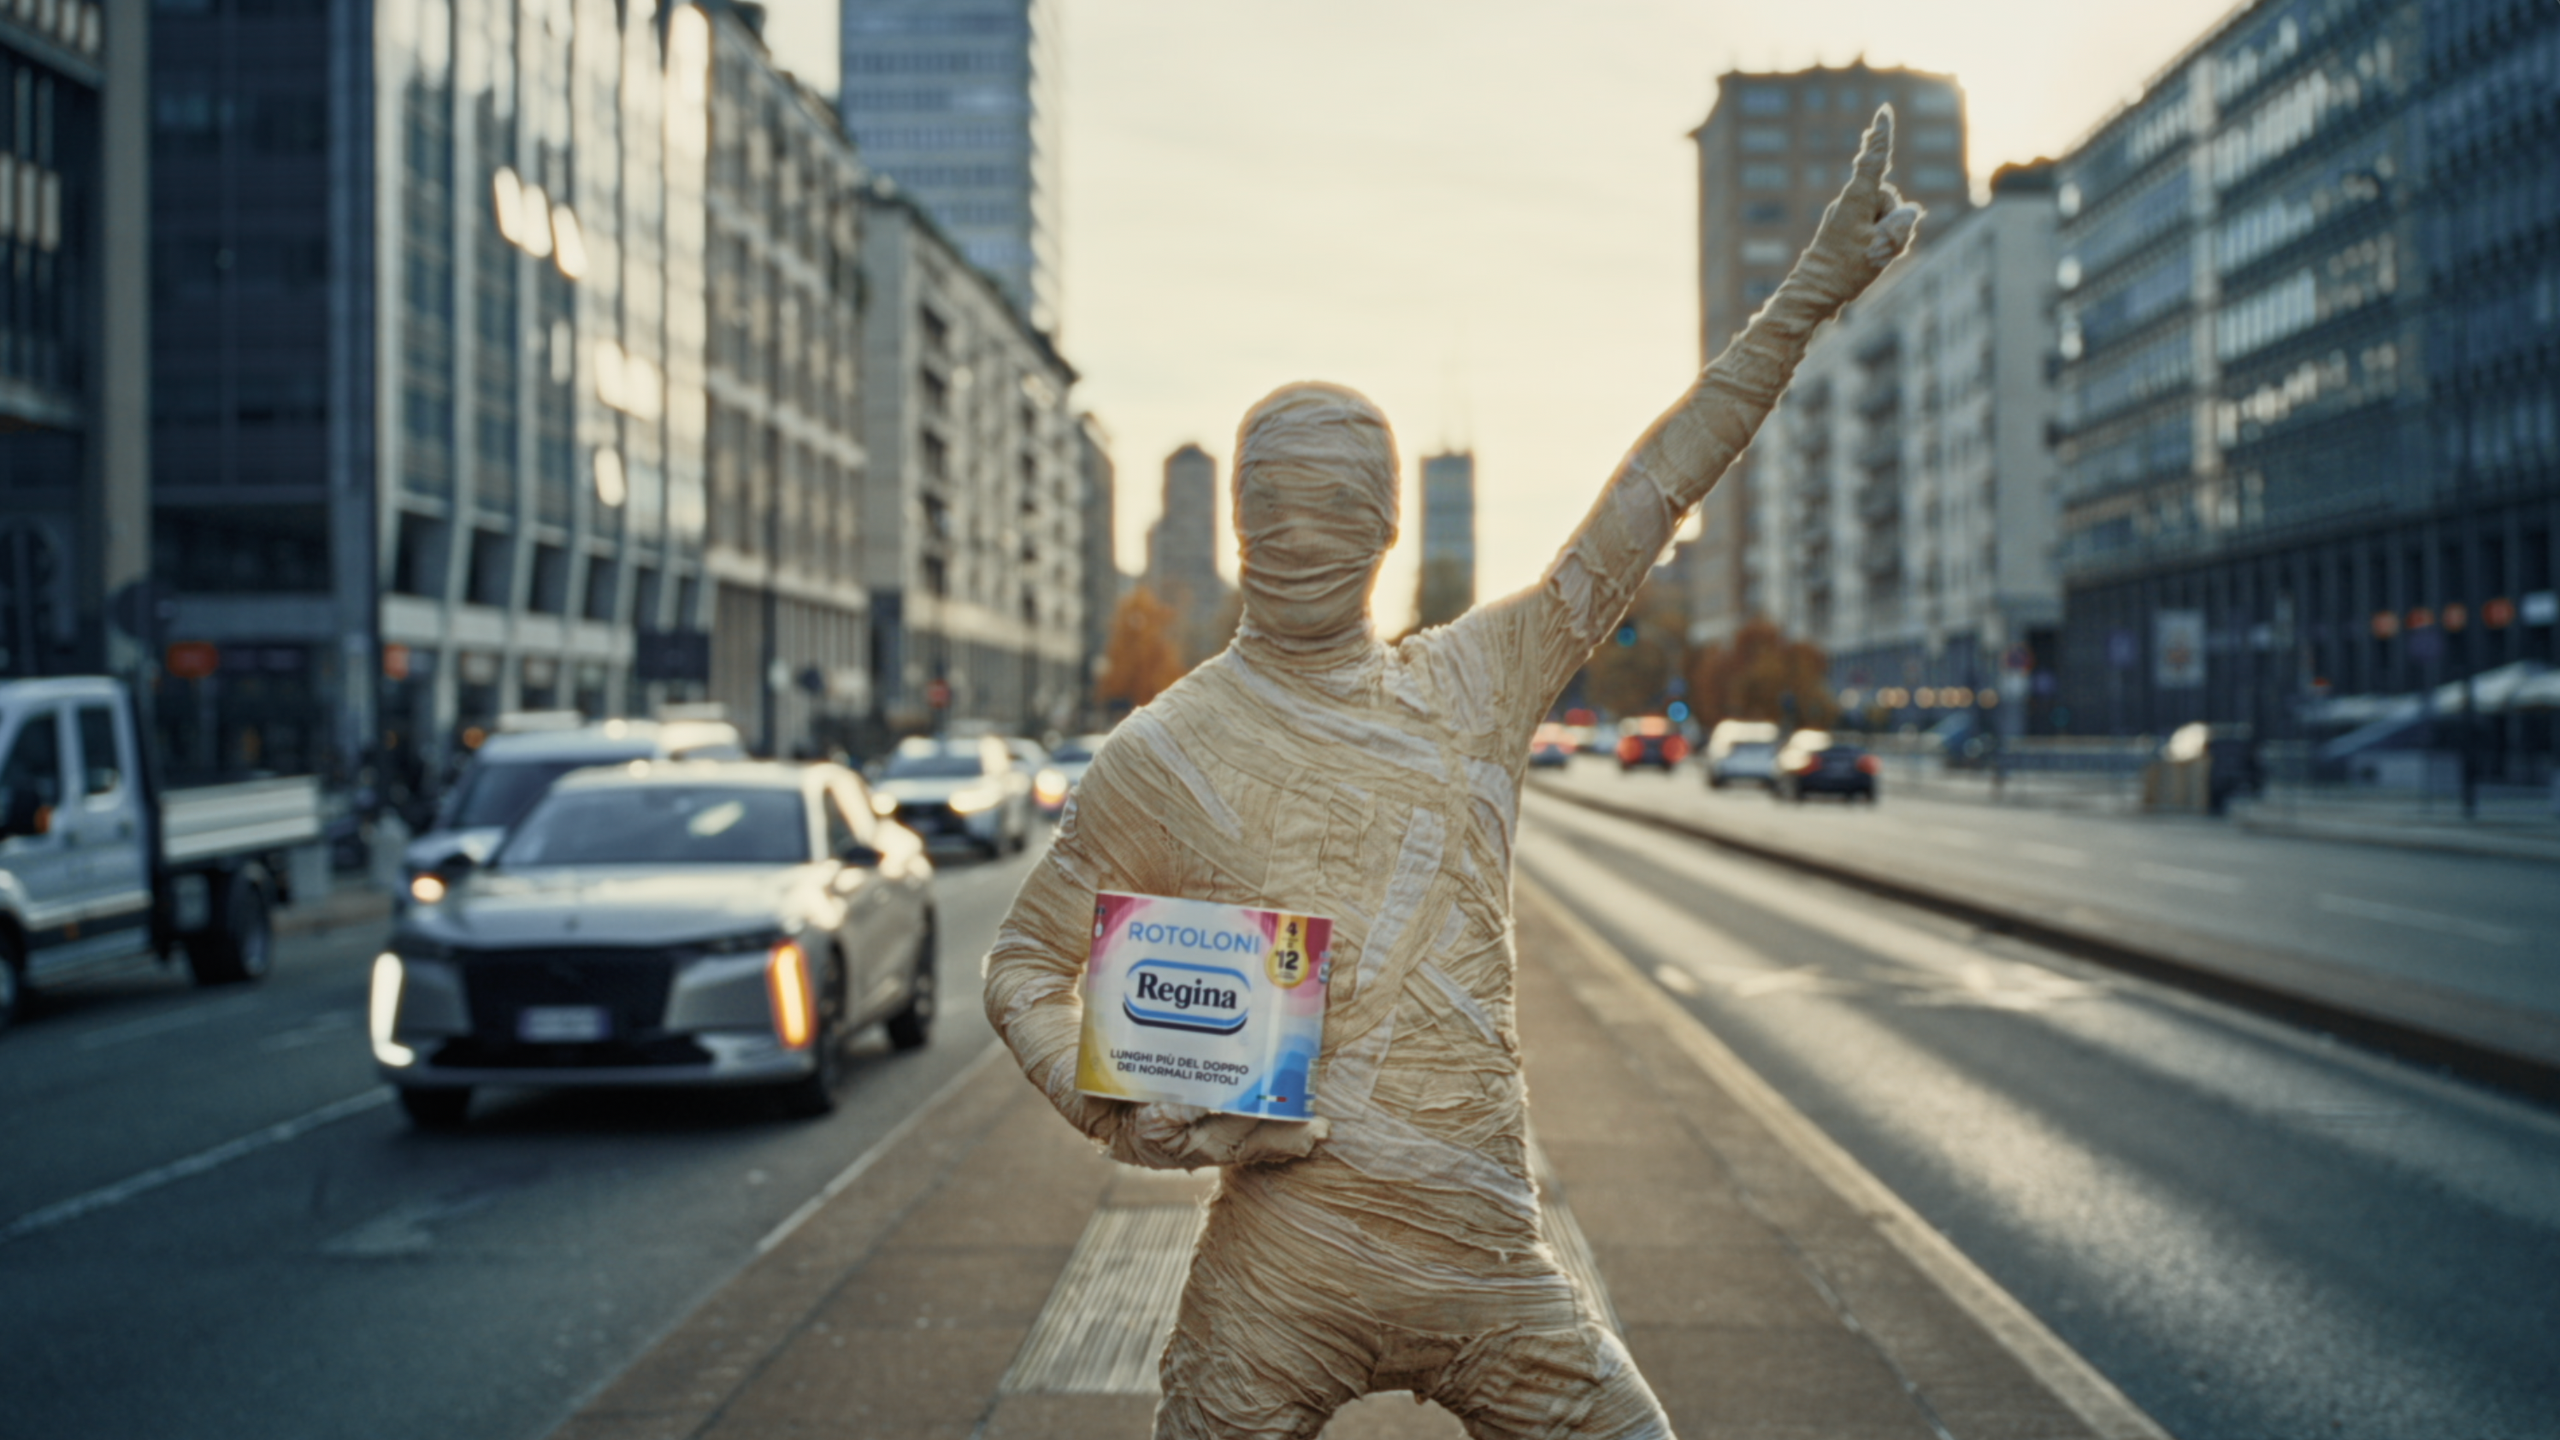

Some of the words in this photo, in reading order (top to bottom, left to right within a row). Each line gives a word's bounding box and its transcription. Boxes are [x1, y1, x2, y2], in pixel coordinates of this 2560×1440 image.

[1127, 921, 1261, 955] ROTOLONI
[1286, 922, 1298, 936] 4
[1275, 951, 1299, 971] 12
[1135, 972, 1238, 1010] Regina
[1110, 1048, 1153, 1063] LUNGHI
[1178, 1057, 1200, 1069] DEL
[1203, 1060, 1249, 1075] DOPPIO
[1117, 1061, 1136, 1073] DEI
[1139, 1065, 1193, 1080] NORMALI
[1195, 1071, 1240, 1086] ROTOLI
